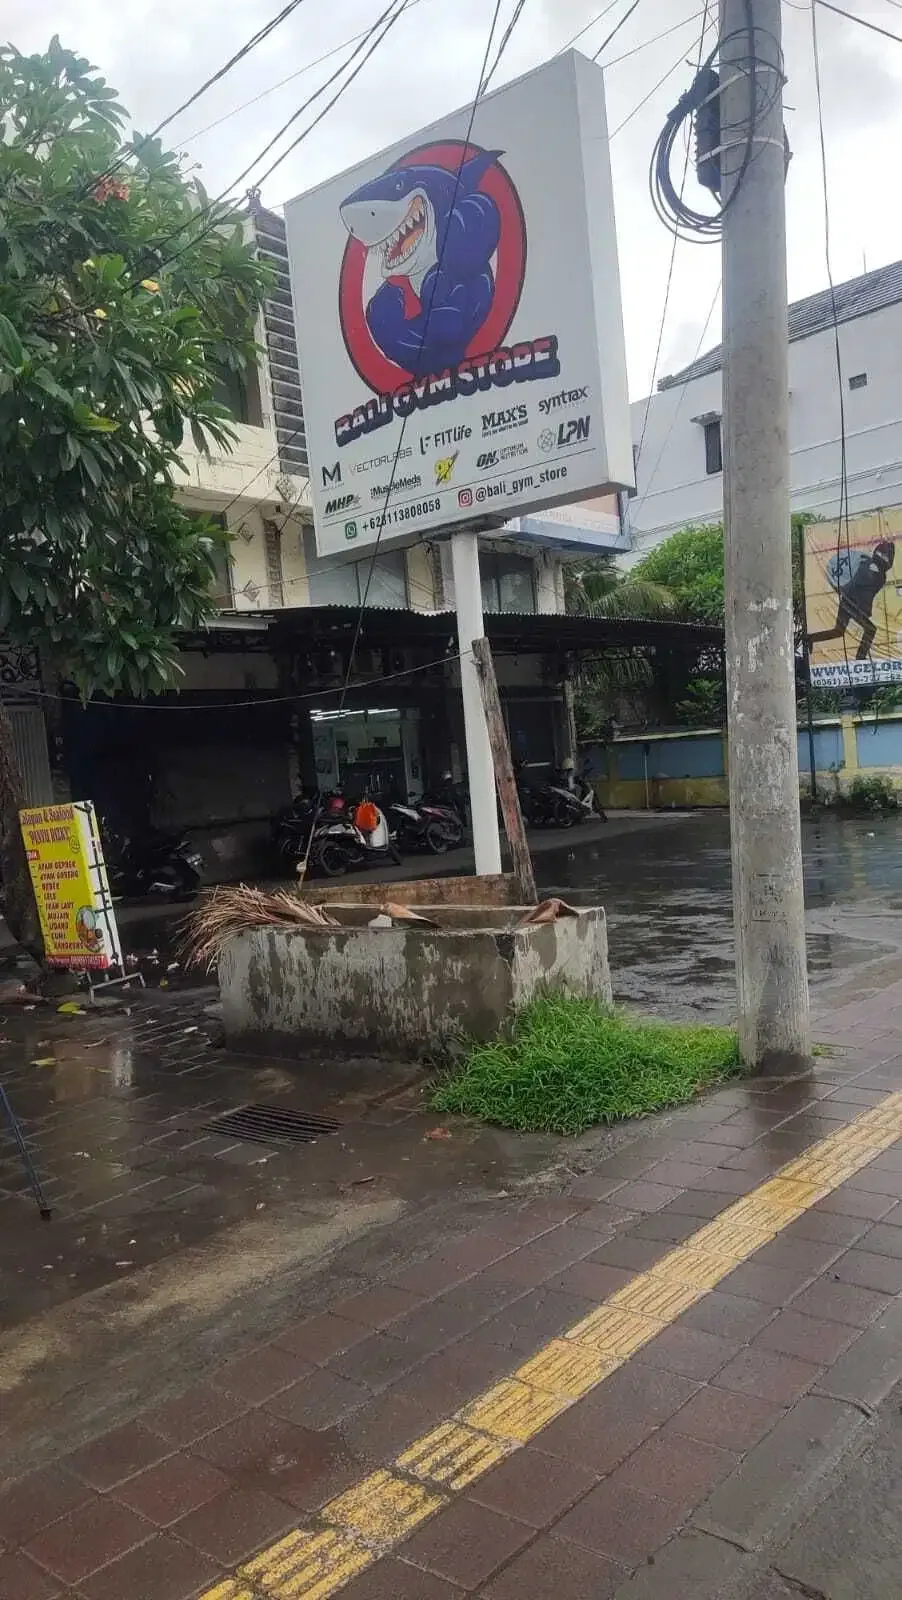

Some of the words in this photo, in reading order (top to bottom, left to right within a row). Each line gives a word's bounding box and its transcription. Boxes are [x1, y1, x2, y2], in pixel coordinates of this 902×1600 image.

[335, 391, 393, 447] BALI
[393, 368, 457, 417] GYM
[457, 335, 560, 396] STORE
[538, 386, 588, 415] syntrax
[482, 405, 527, 430] MAX'S
[557, 416, 590, 445] LPN
[475, 465, 568, 502] @bali_gym_store
[325, 494, 354, 513] MHP
[362, 497, 441, 531] +628113808058
